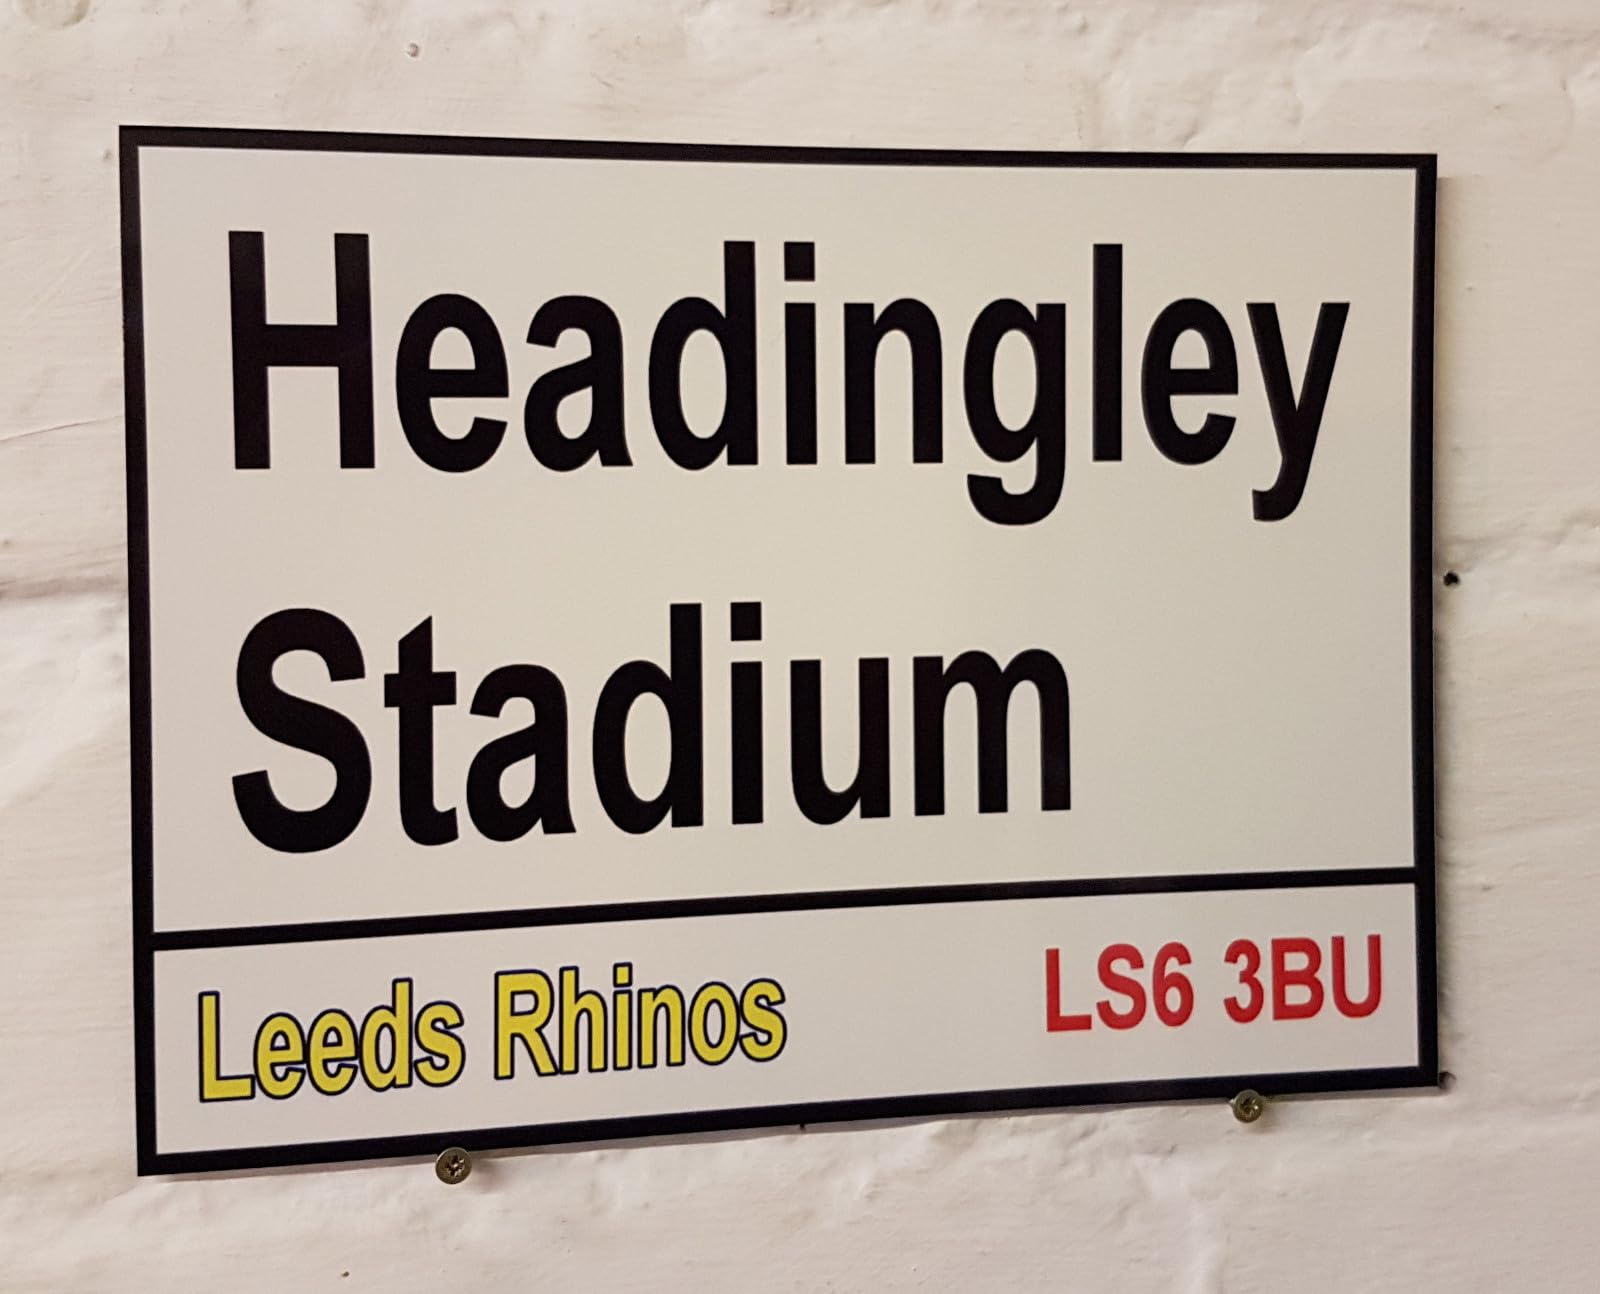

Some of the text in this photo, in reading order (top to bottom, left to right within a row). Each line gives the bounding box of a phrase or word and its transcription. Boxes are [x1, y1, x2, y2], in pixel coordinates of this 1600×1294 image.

[229, 231, 1350, 525] Headingley
[232, 602, 1071, 853] Stadium
[198, 962, 787, 1103] Leeds Rhinos
[1045, 933, 1382, 1032] LS6 3BU
